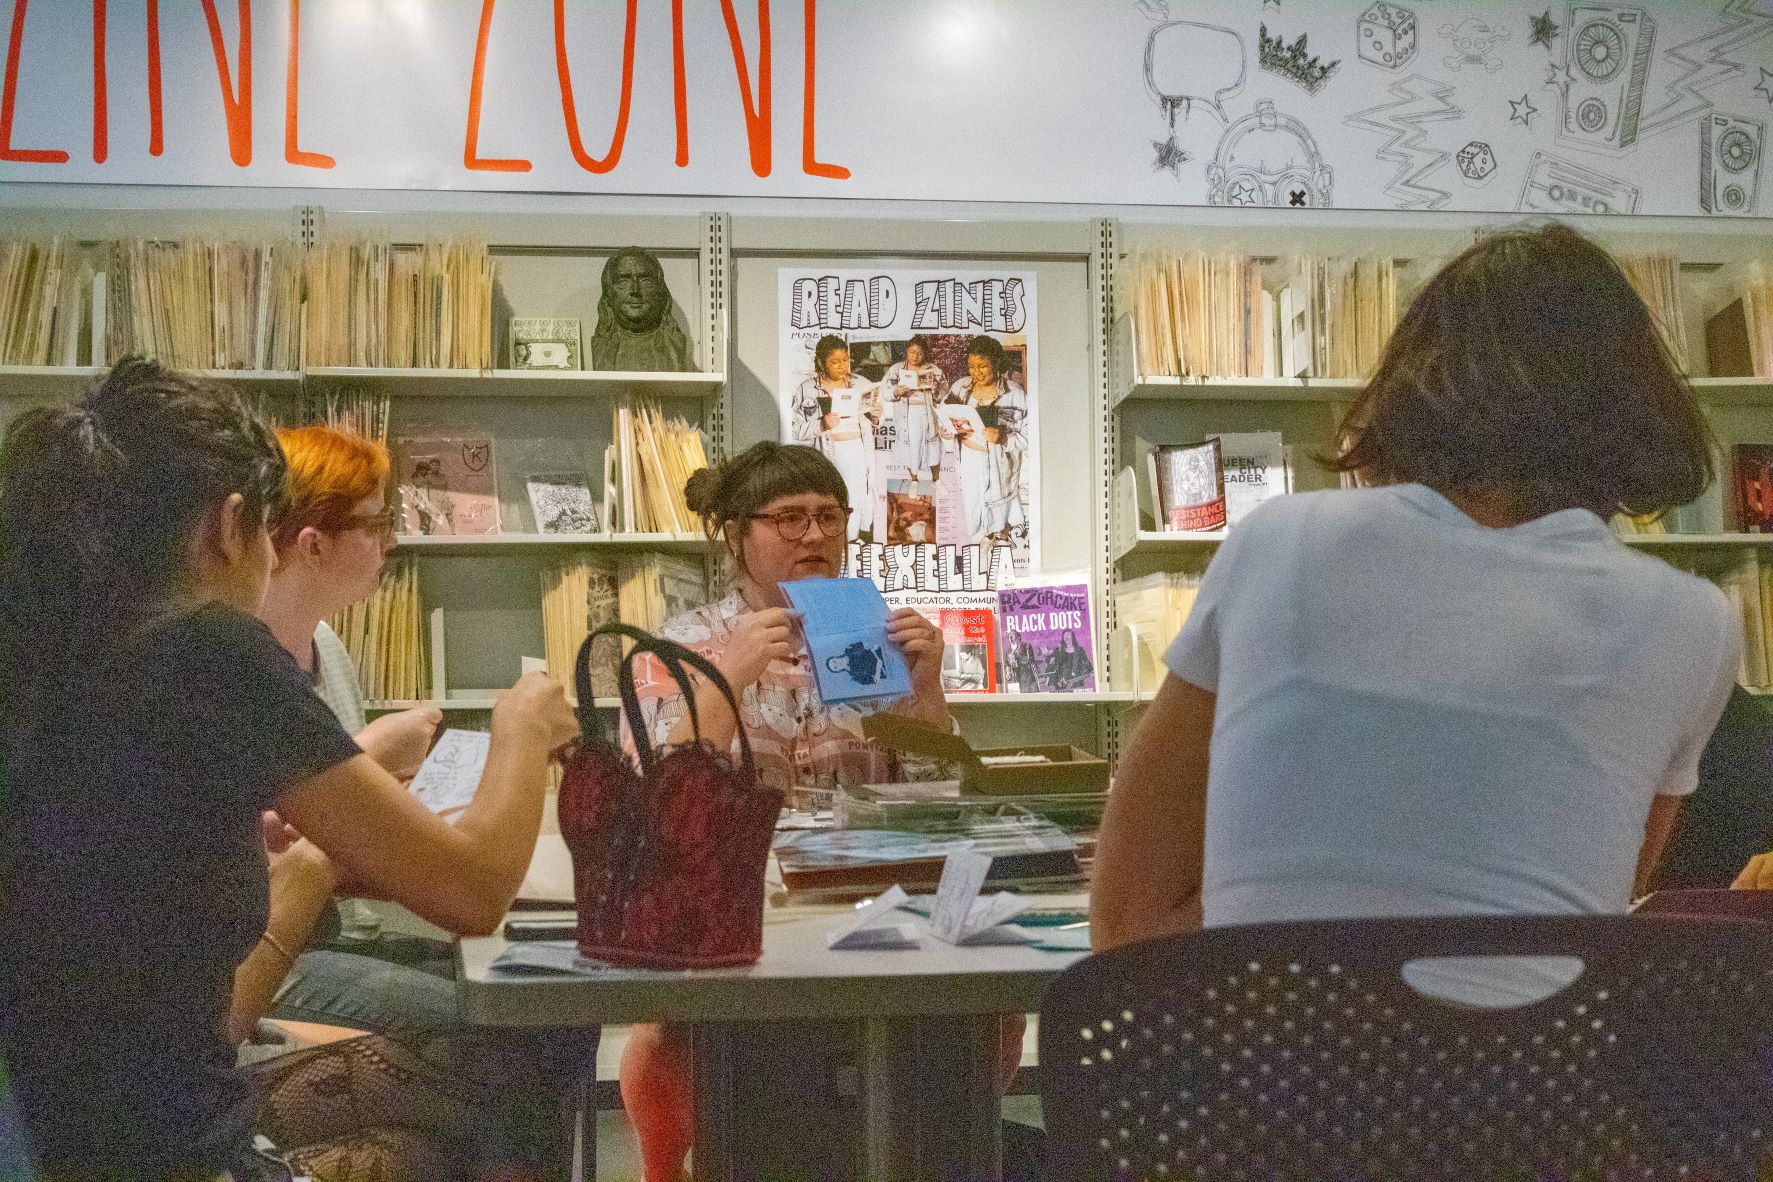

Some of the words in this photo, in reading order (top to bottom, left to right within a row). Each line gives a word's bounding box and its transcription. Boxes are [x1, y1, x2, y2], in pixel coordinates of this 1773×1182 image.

[791, 275, 898, 330] READ
[910, 277, 1026, 334] ZINES
[1223, 457, 1255, 467] UEEN
[1239, 465, 1268, 475] CITY
[1224, 474, 1263, 483] EADER
[1168, 501, 1225, 520] RESISTANCE
[1203, 511, 1225, 526] BARS
[840, 540, 1014, 592] EEXELLA
[906, 597, 954, 605] EDUCATOR,
[956, 596, 999, 605] COMMUN
[1000, 588, 1087, 613] RAZORCAKE
[1006, 612, 1046, 634] BLACK
[1050, 611, 1082, 630] DOTS
